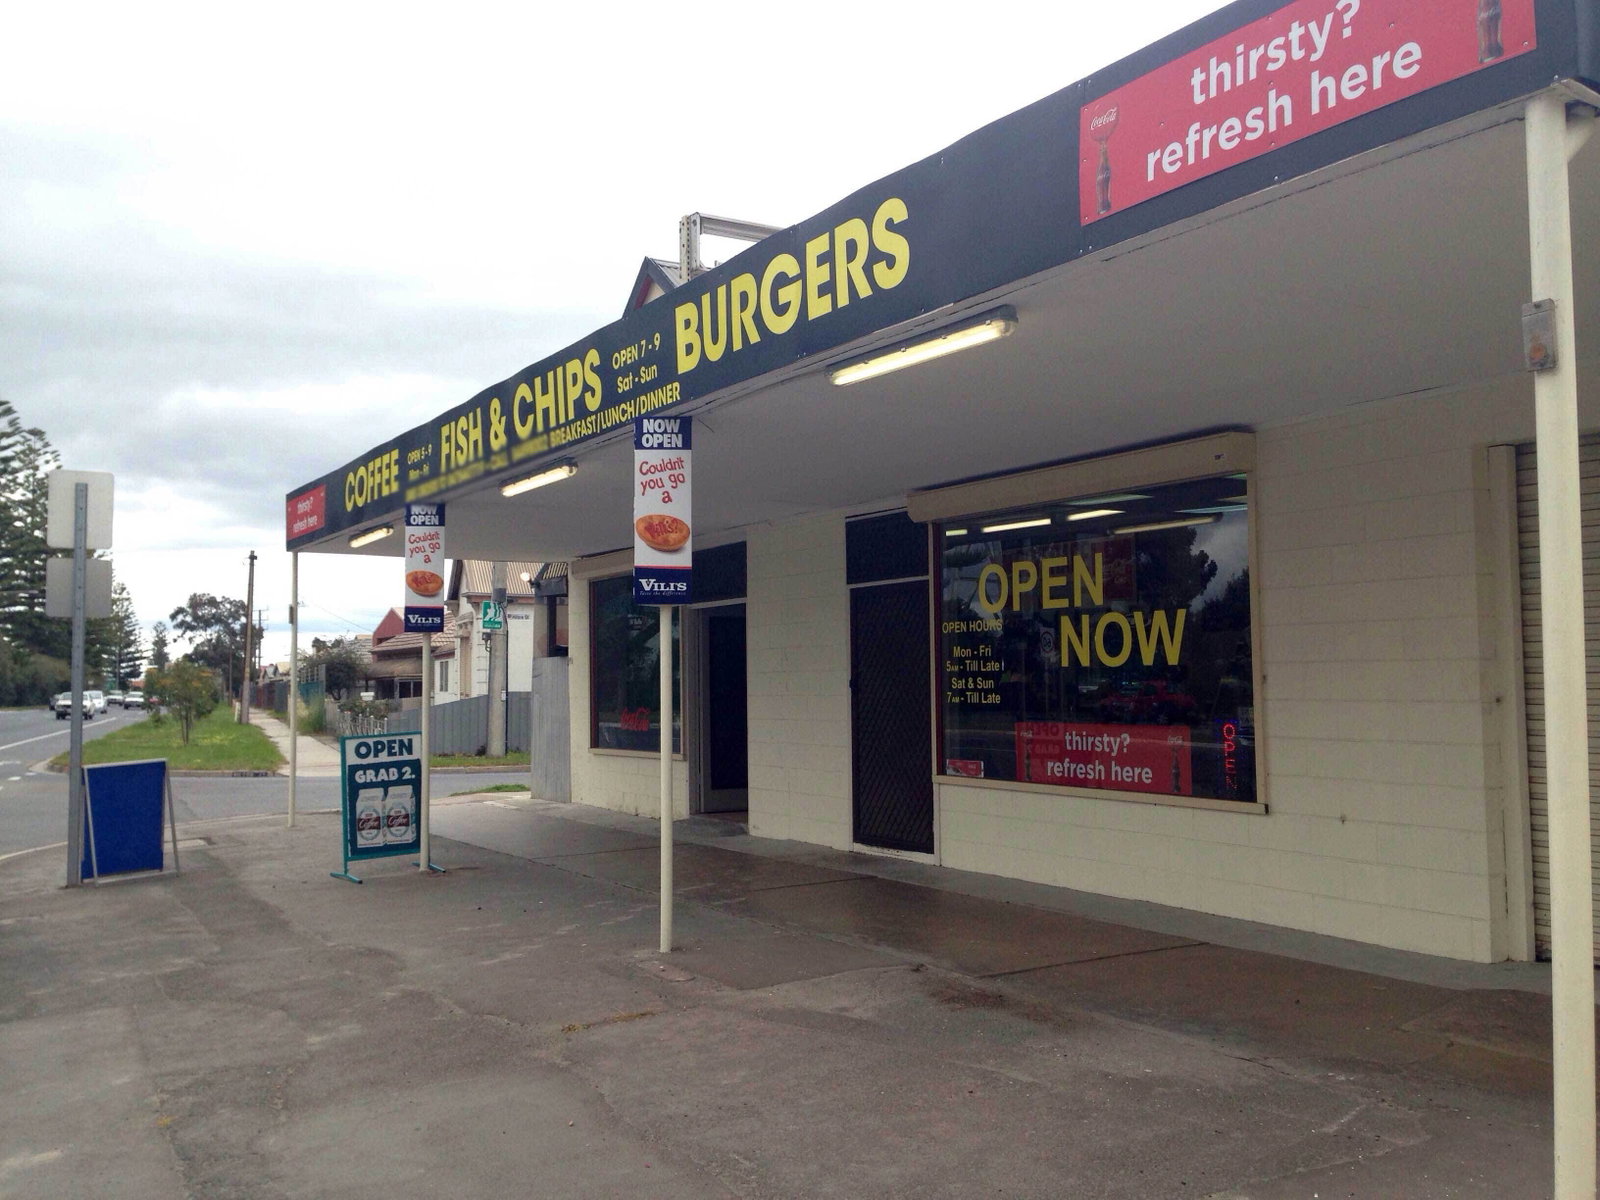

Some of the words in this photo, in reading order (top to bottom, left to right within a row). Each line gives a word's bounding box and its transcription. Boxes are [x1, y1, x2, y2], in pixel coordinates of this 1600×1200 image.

[1191, 0, 1361, 105] thirsty?
[1147, 88, 1293, 182] refresh
[1310, 41, 1422, 115] here
[674, 197, 910, 375] BURGERS
[612, 341, 639, 370] OPEN
[639, 339, 646, 358] 7
[653, 332, 661, 350] 9
[617, 374, 634, 394] Sat
[640, 364, 658, 387] Sun
[440, 407, 484, 474] FISH
[489, 397, 507, 452] &
[513, 348, 602, 440] CHIPS
[642, 418, 681, 434] NOW
[641, 433, 683, 448] OPEN
[407, 449, 421, 465] OPEN
[639, 457, 684, 476] Couldn't
[344, 448, 399, 512] COFFEE
[640, 478, 665, 496] you
[668, 473, 685, 490] go
[661, 491, 672, 504] a
[411, 503, 437, 515] NOW
[410, 515, 439, 525] OPEN
[408, 545, 426, 558] you
[428, 542, 441, 554] go
[423, 554, 431, 564] a
[978, 552, 1104, 614] OPEN
[942, 621, 967, 634] OPEN
[969, 619, 1003, 632] HOURS
[1060, 608, 1187, 668] NOW
[953, 646, 972, 658] Mon
[979, 645, 991, 657] Fri
[965, 660, 978, 672] Till
[980, 660, 1000, 672] Late
[952, 677, 966, 689] Sat
[967, 677, 975, 689] &
[977, 677, 994, 689] Sun
[966, 692, 979, 703] Till
[981, 692, 1001, 704] Late
[354, 738, 413, 759] OPEN
[1065, 731, 1130, 756] thirsty?
[354, 769, 399, 783] GRAB
[1047, 758, 1105, 781] refresh
[1111, 761, 1153, 784] here
